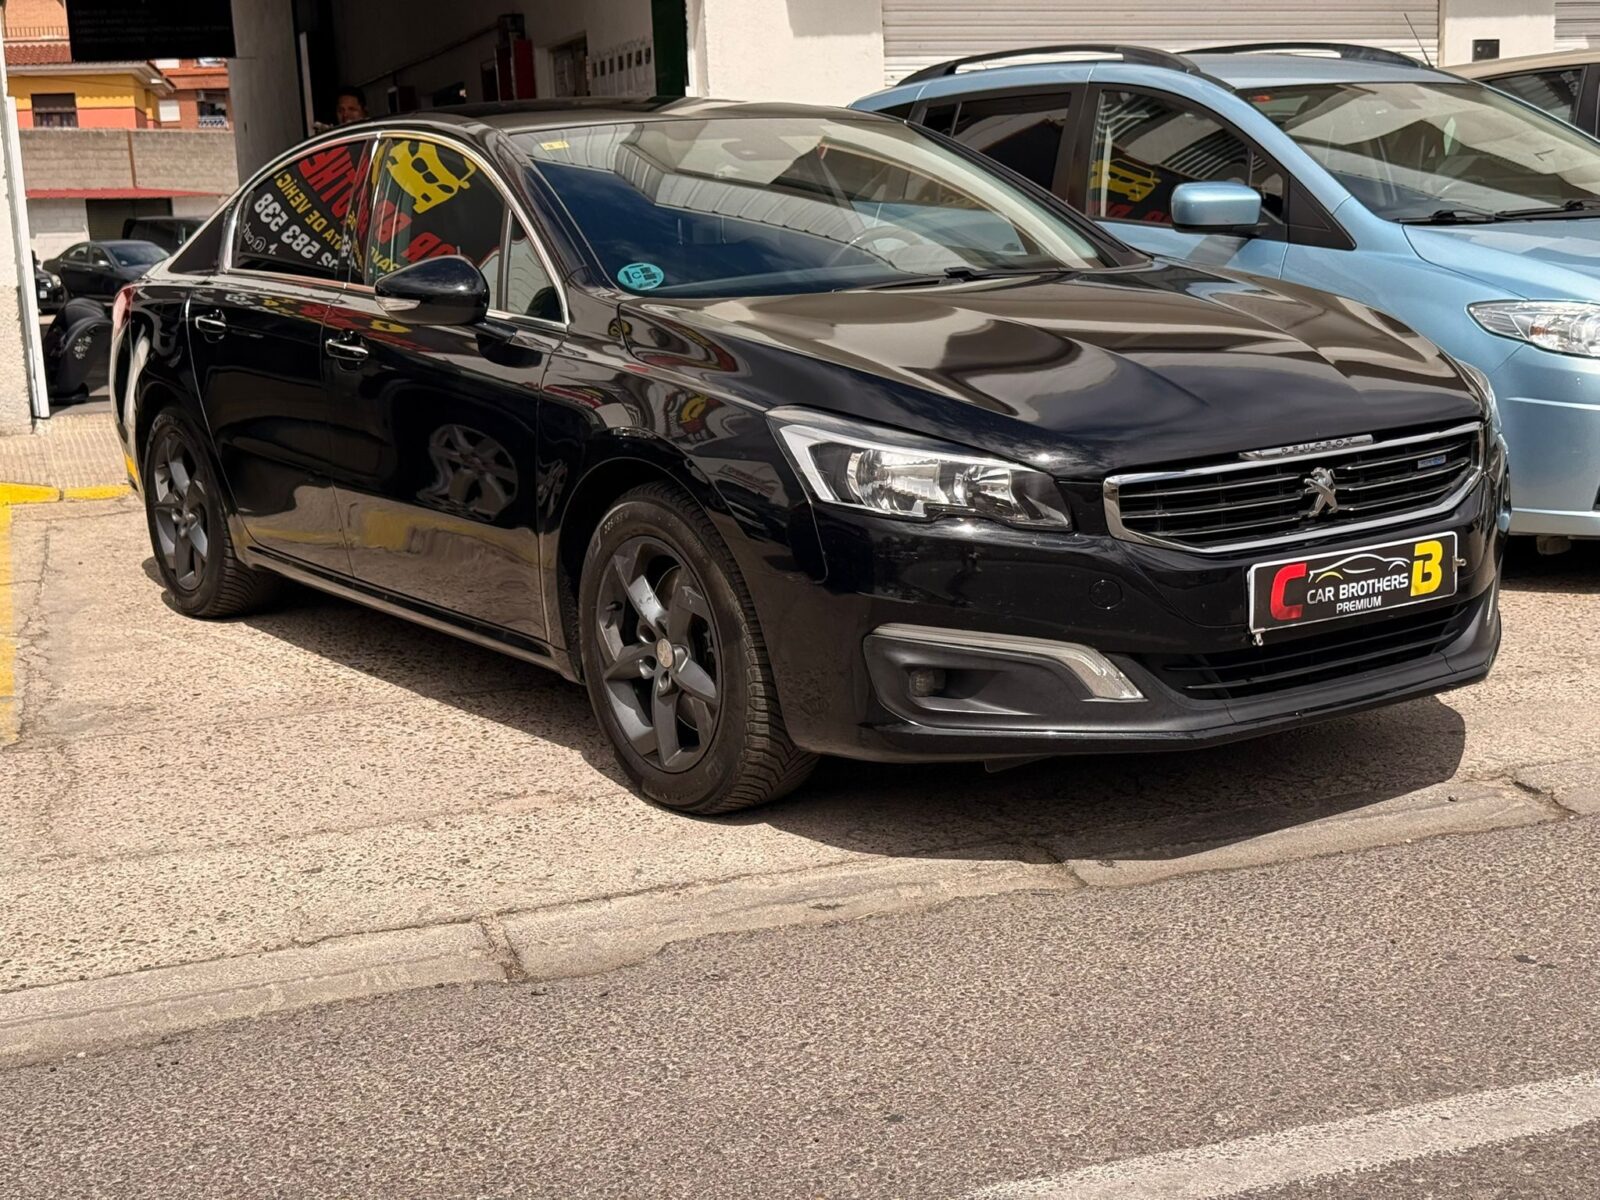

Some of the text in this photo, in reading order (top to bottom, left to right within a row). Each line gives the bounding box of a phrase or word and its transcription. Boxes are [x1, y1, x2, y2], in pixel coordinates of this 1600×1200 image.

[1280, 438, 1354, 455] PEUGEOT
[1410, 540, 1443, 597] B
[1270, 562, 1307, 620] C
[1307, 573, 1409, 604] CAR BROTHERS
[1336, 596, 1382, 613] PREMIUM
